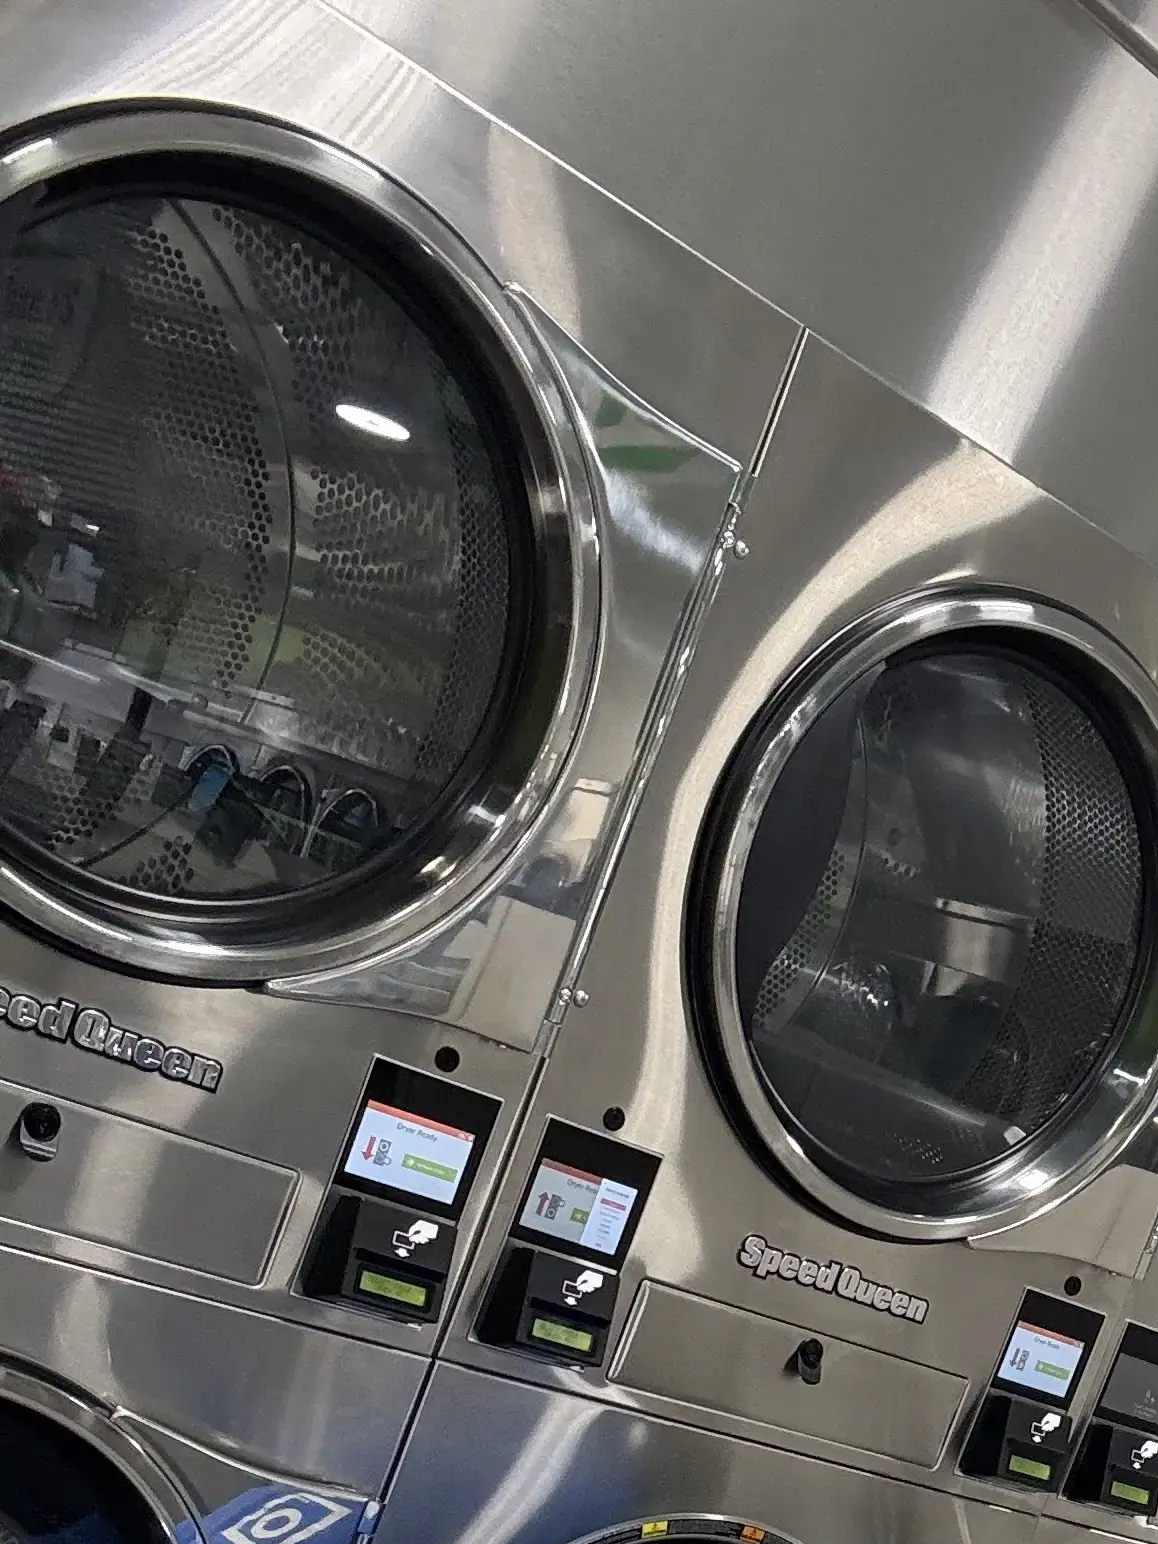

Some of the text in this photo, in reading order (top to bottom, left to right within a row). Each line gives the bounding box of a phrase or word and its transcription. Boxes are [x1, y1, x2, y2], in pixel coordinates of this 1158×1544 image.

[71, 1007, 223, 1094] Queen
[396, 1122, 438, 1142] Dryer Ready
[736, 1234, 929, 1324] Speed Queen
